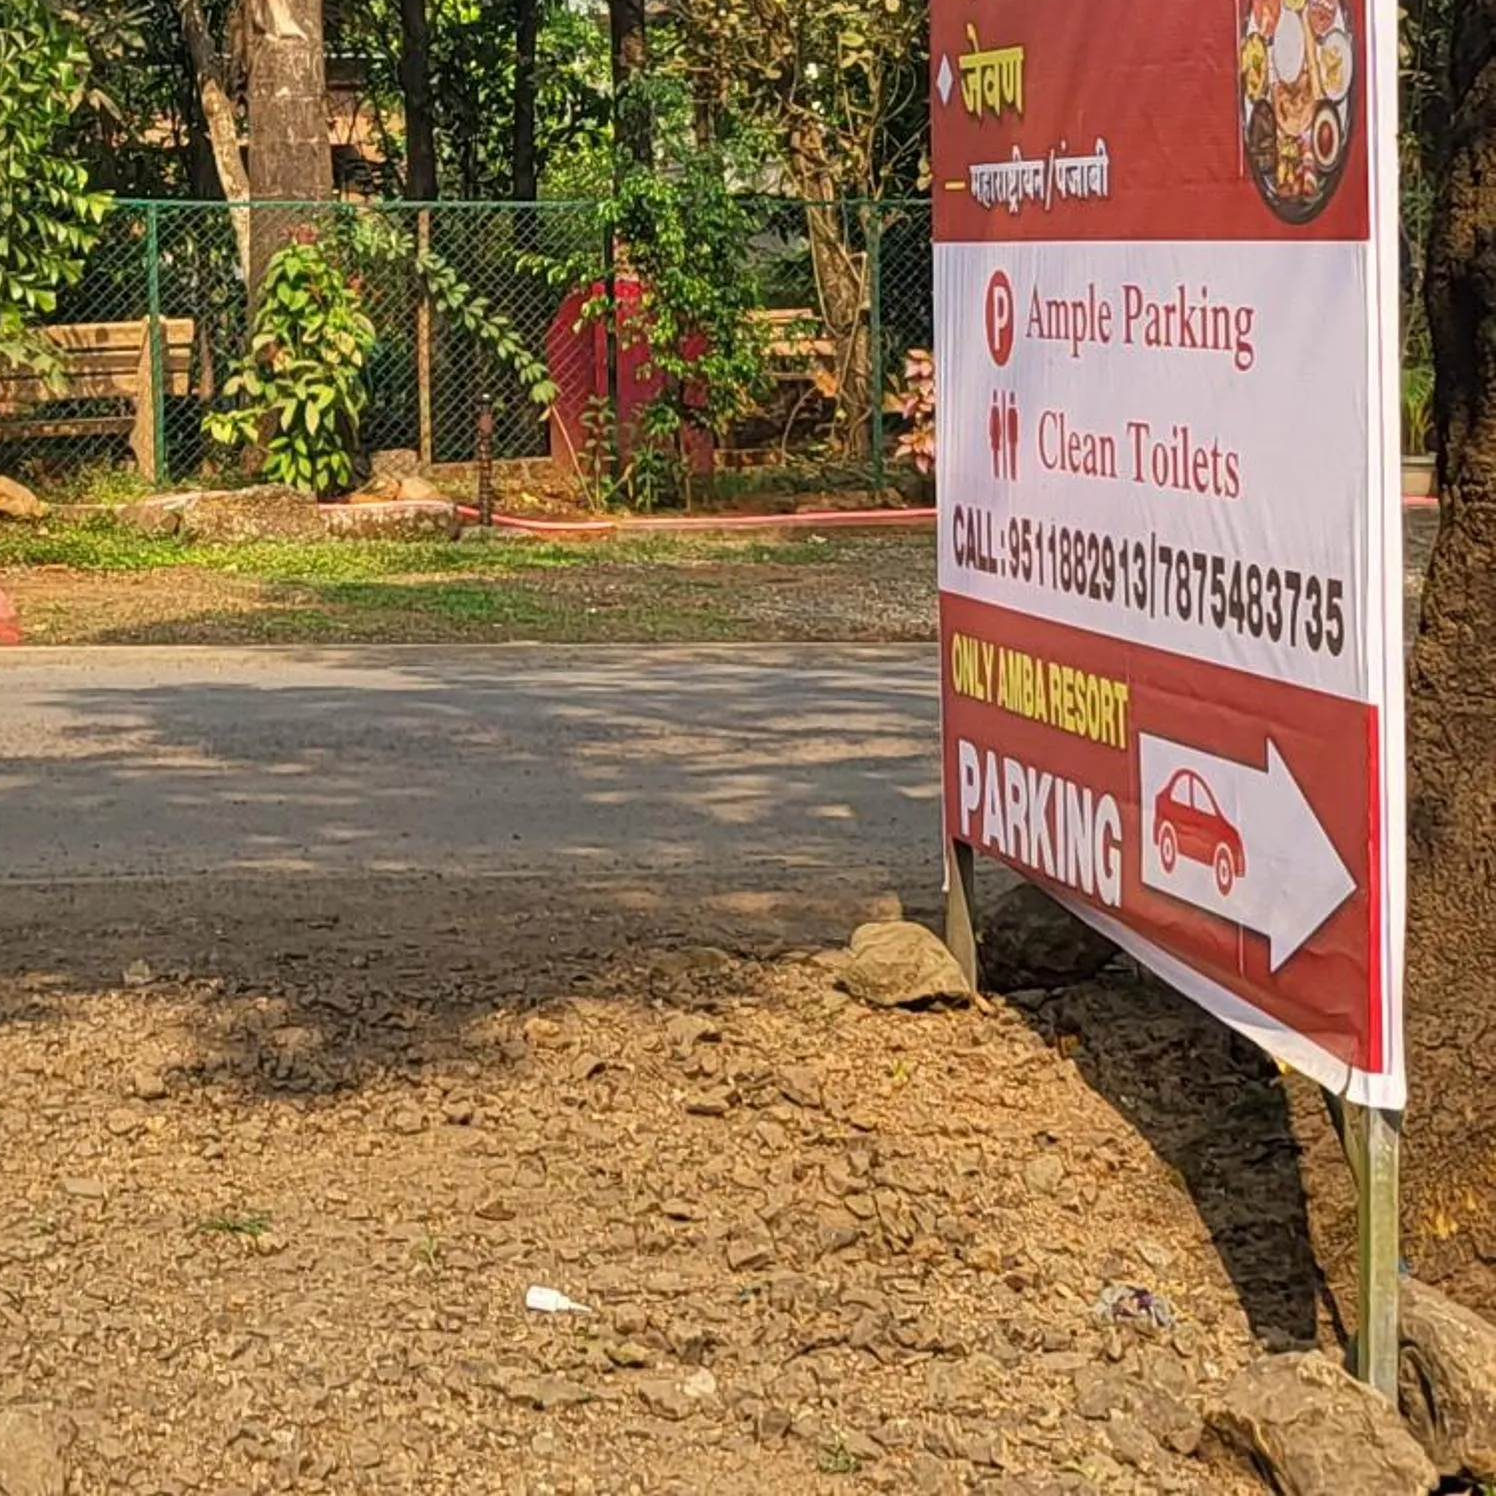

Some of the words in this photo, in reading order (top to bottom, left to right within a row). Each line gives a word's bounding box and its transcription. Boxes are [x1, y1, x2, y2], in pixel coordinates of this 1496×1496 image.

[958, 22, 1024, 118] जेवण
[1026, 282, 1112, 358] Ample
[1121, 284, 1255, 372] Parking
[1038, 410, 1117, 478] Clean
[1126, 422, 1240, 499] Toilets
[951, 632, 995, 698] ONLY
[998, 646, 1048, 725] AMBA
[1048, 662, 1129, 750] RESORT
[958, 737, 1124, 909] PARKING
